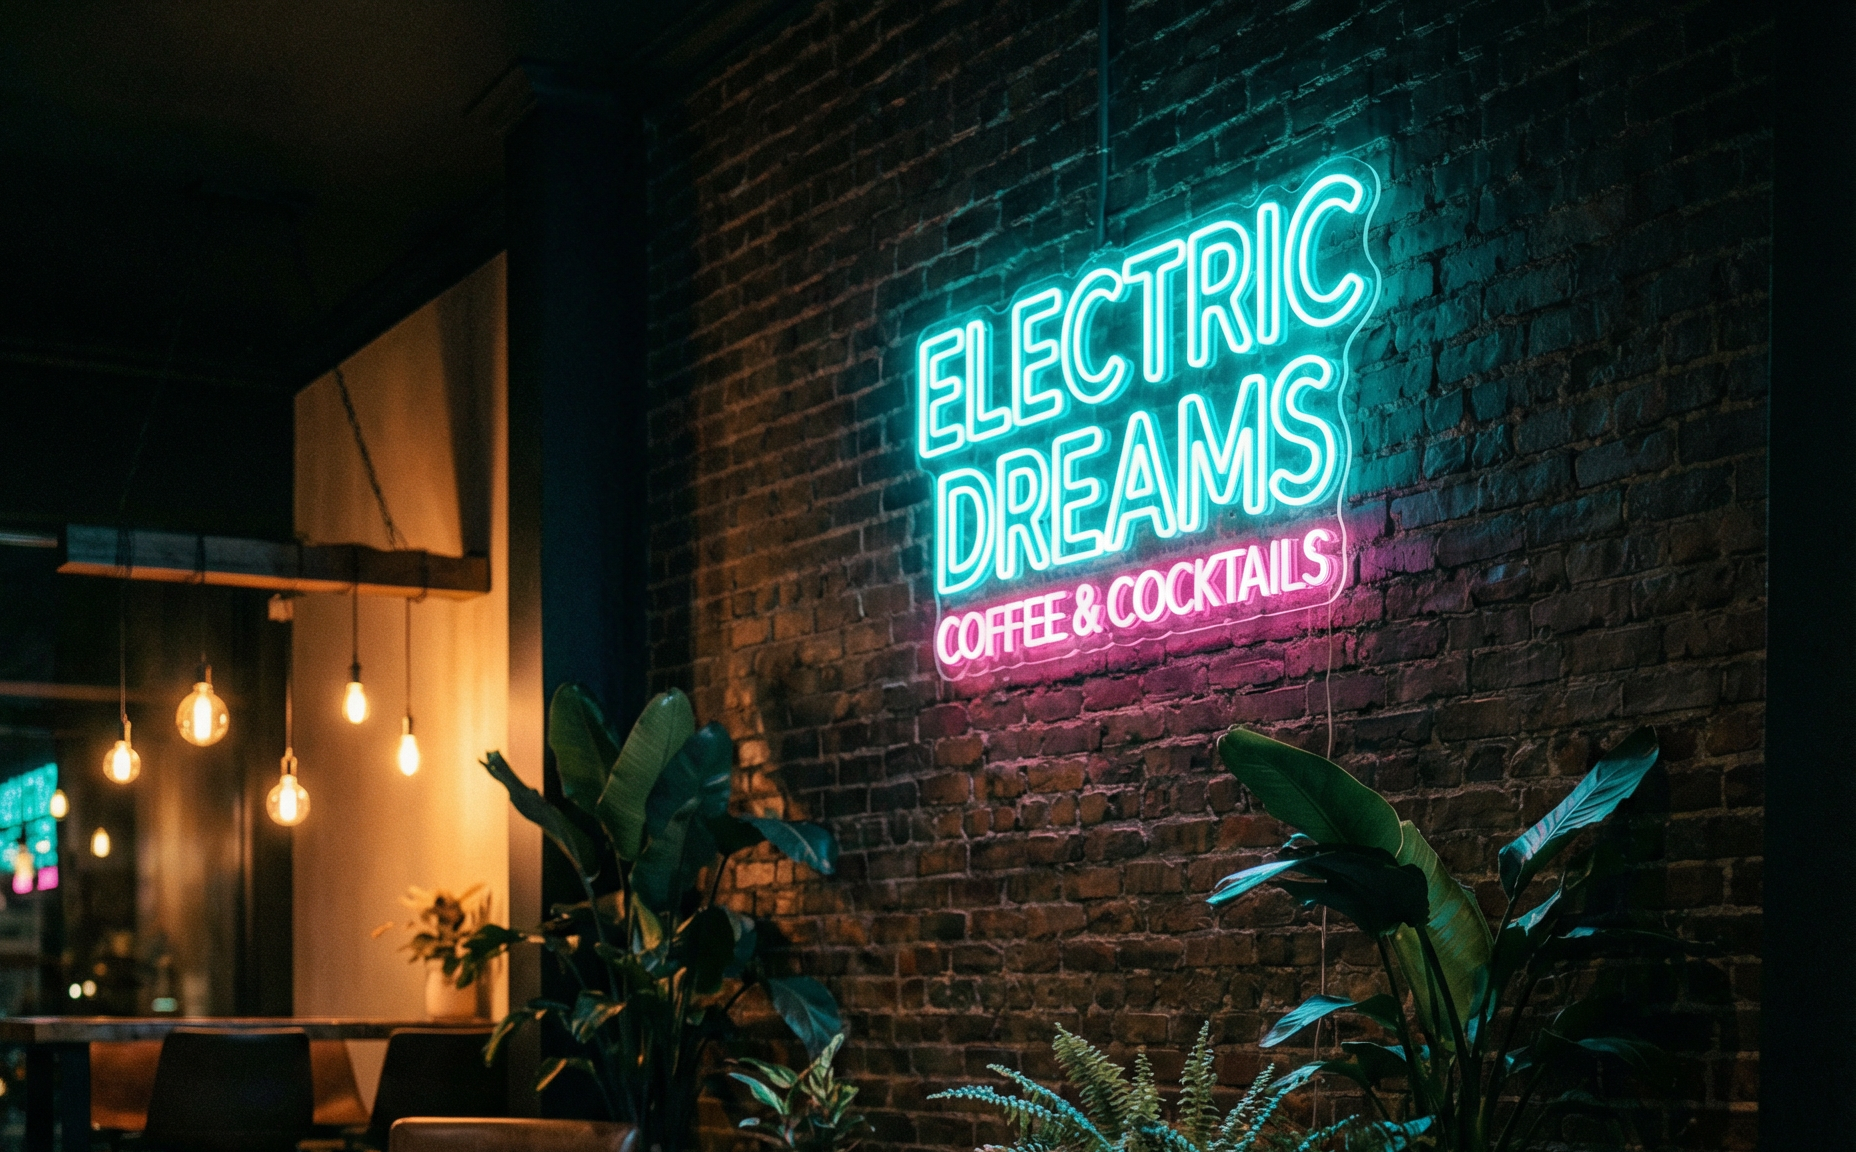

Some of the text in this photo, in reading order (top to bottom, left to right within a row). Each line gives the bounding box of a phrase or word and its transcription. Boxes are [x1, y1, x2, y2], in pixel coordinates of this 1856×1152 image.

[918, 173, 1368, 460] ELECTRIC
[937, 354, 1341, 595] DREAMS
[936, 528, 1334, 666] COFFEE & COCKTAILS
